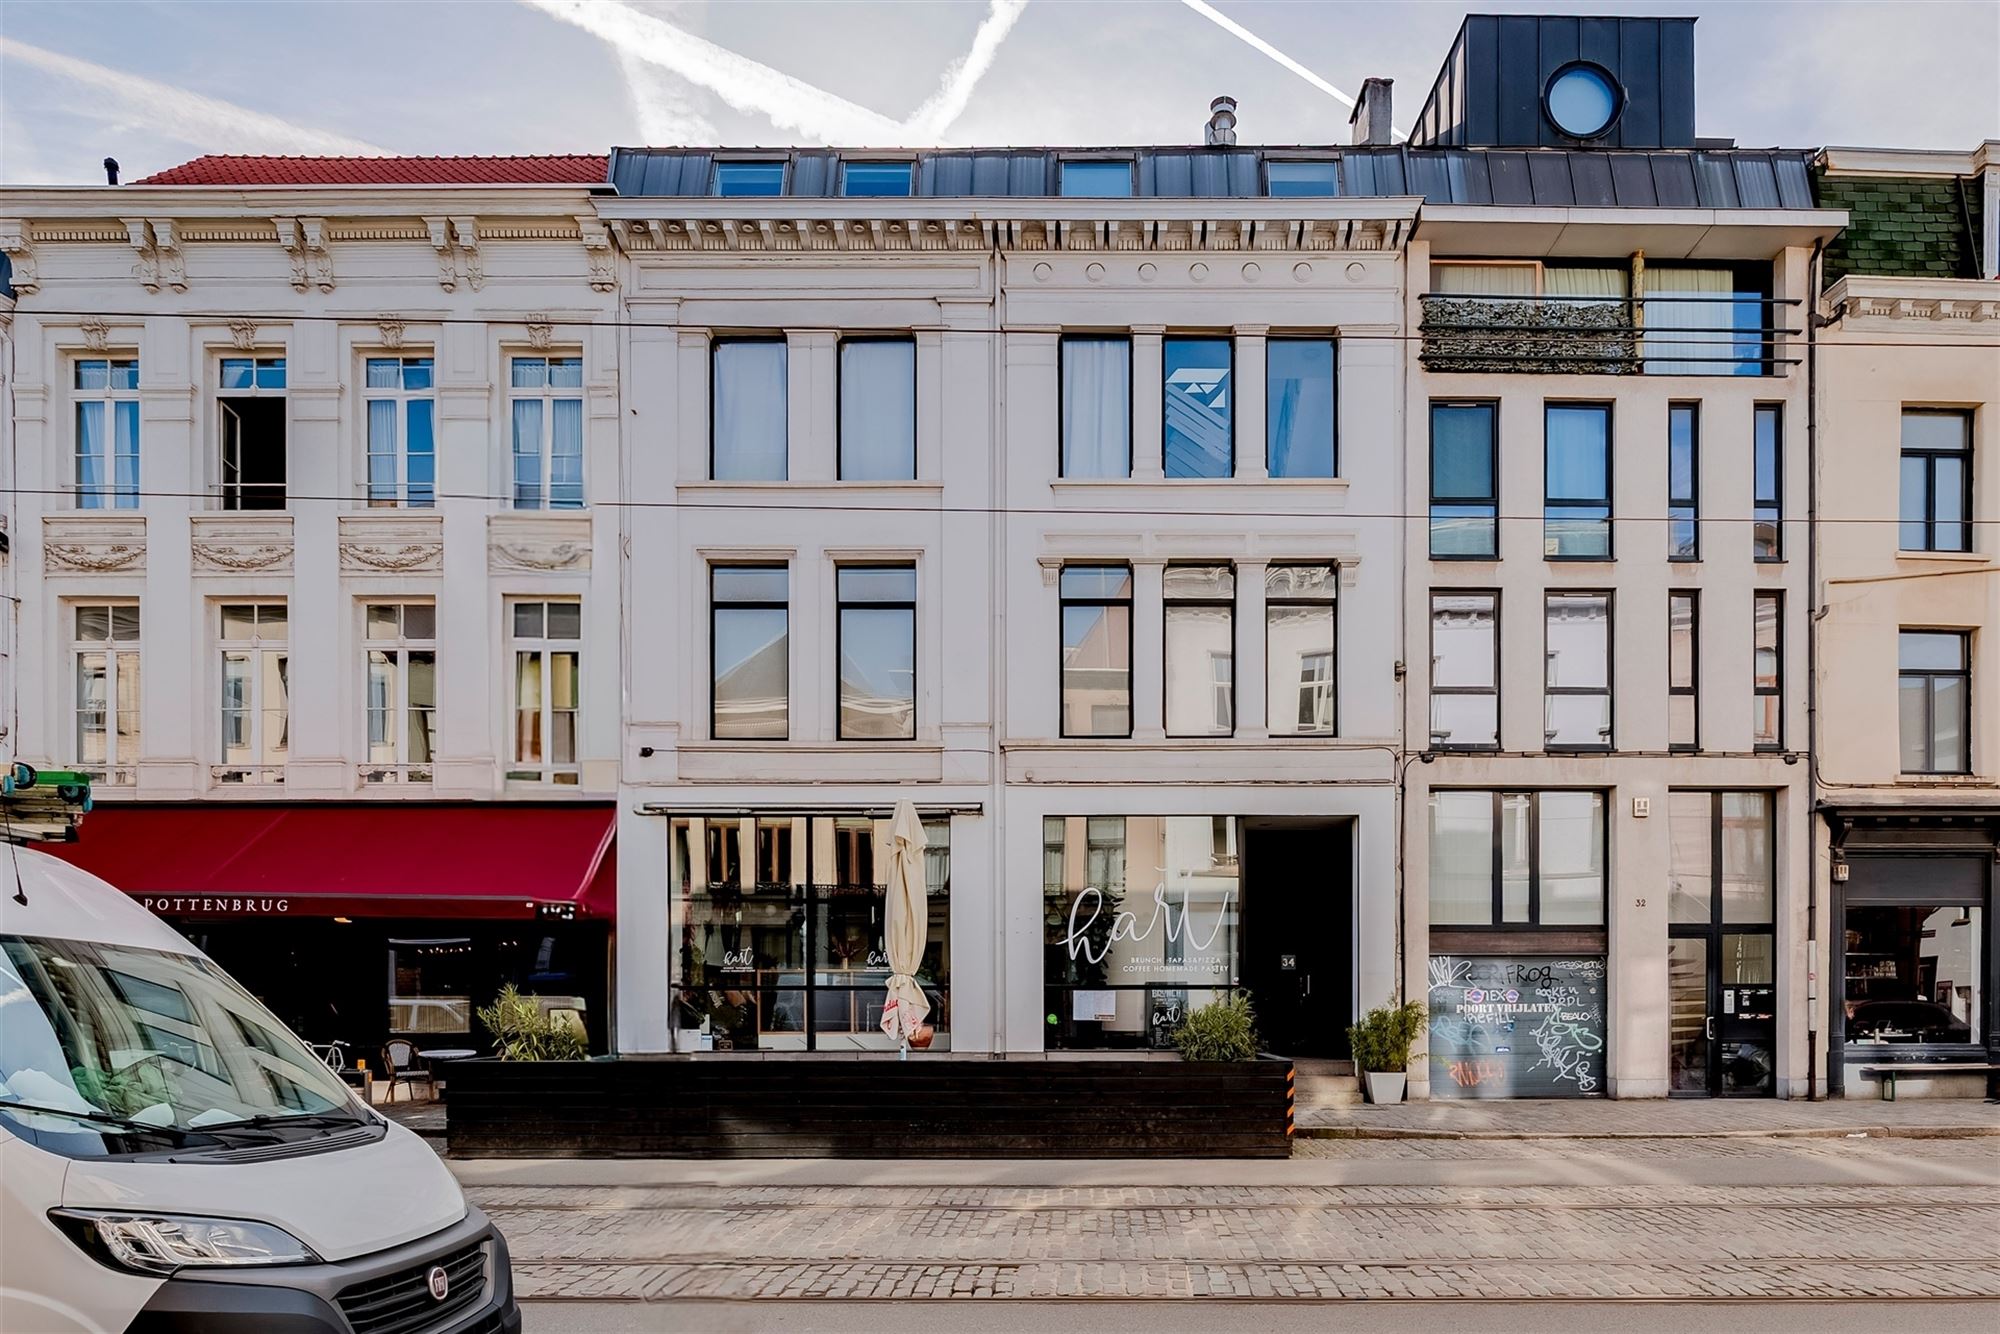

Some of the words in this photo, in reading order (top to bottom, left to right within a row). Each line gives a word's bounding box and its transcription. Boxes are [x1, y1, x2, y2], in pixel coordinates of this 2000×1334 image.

[144, 898, 289, 912] POTTENBRUG
[1635, 898, 1647, 908] 32
[1056, 858, 1230, 964] hart
[723, 946, 754, 966] hart
[866, 950, 890, 966] har
[1282, 957, 1296, 968] 34
[1122, 965, 1151, 973] COFFEE
[1153, 965, 1198, 973] HOMEMADE
[1200, 965, 1230, 973] PASTRY
[1152, 1003, 1181, 1026] hart
[1456, 1003, 1494, 1014] POORT
[1496, 1002, 1561, 1013] VRIJLATEN
